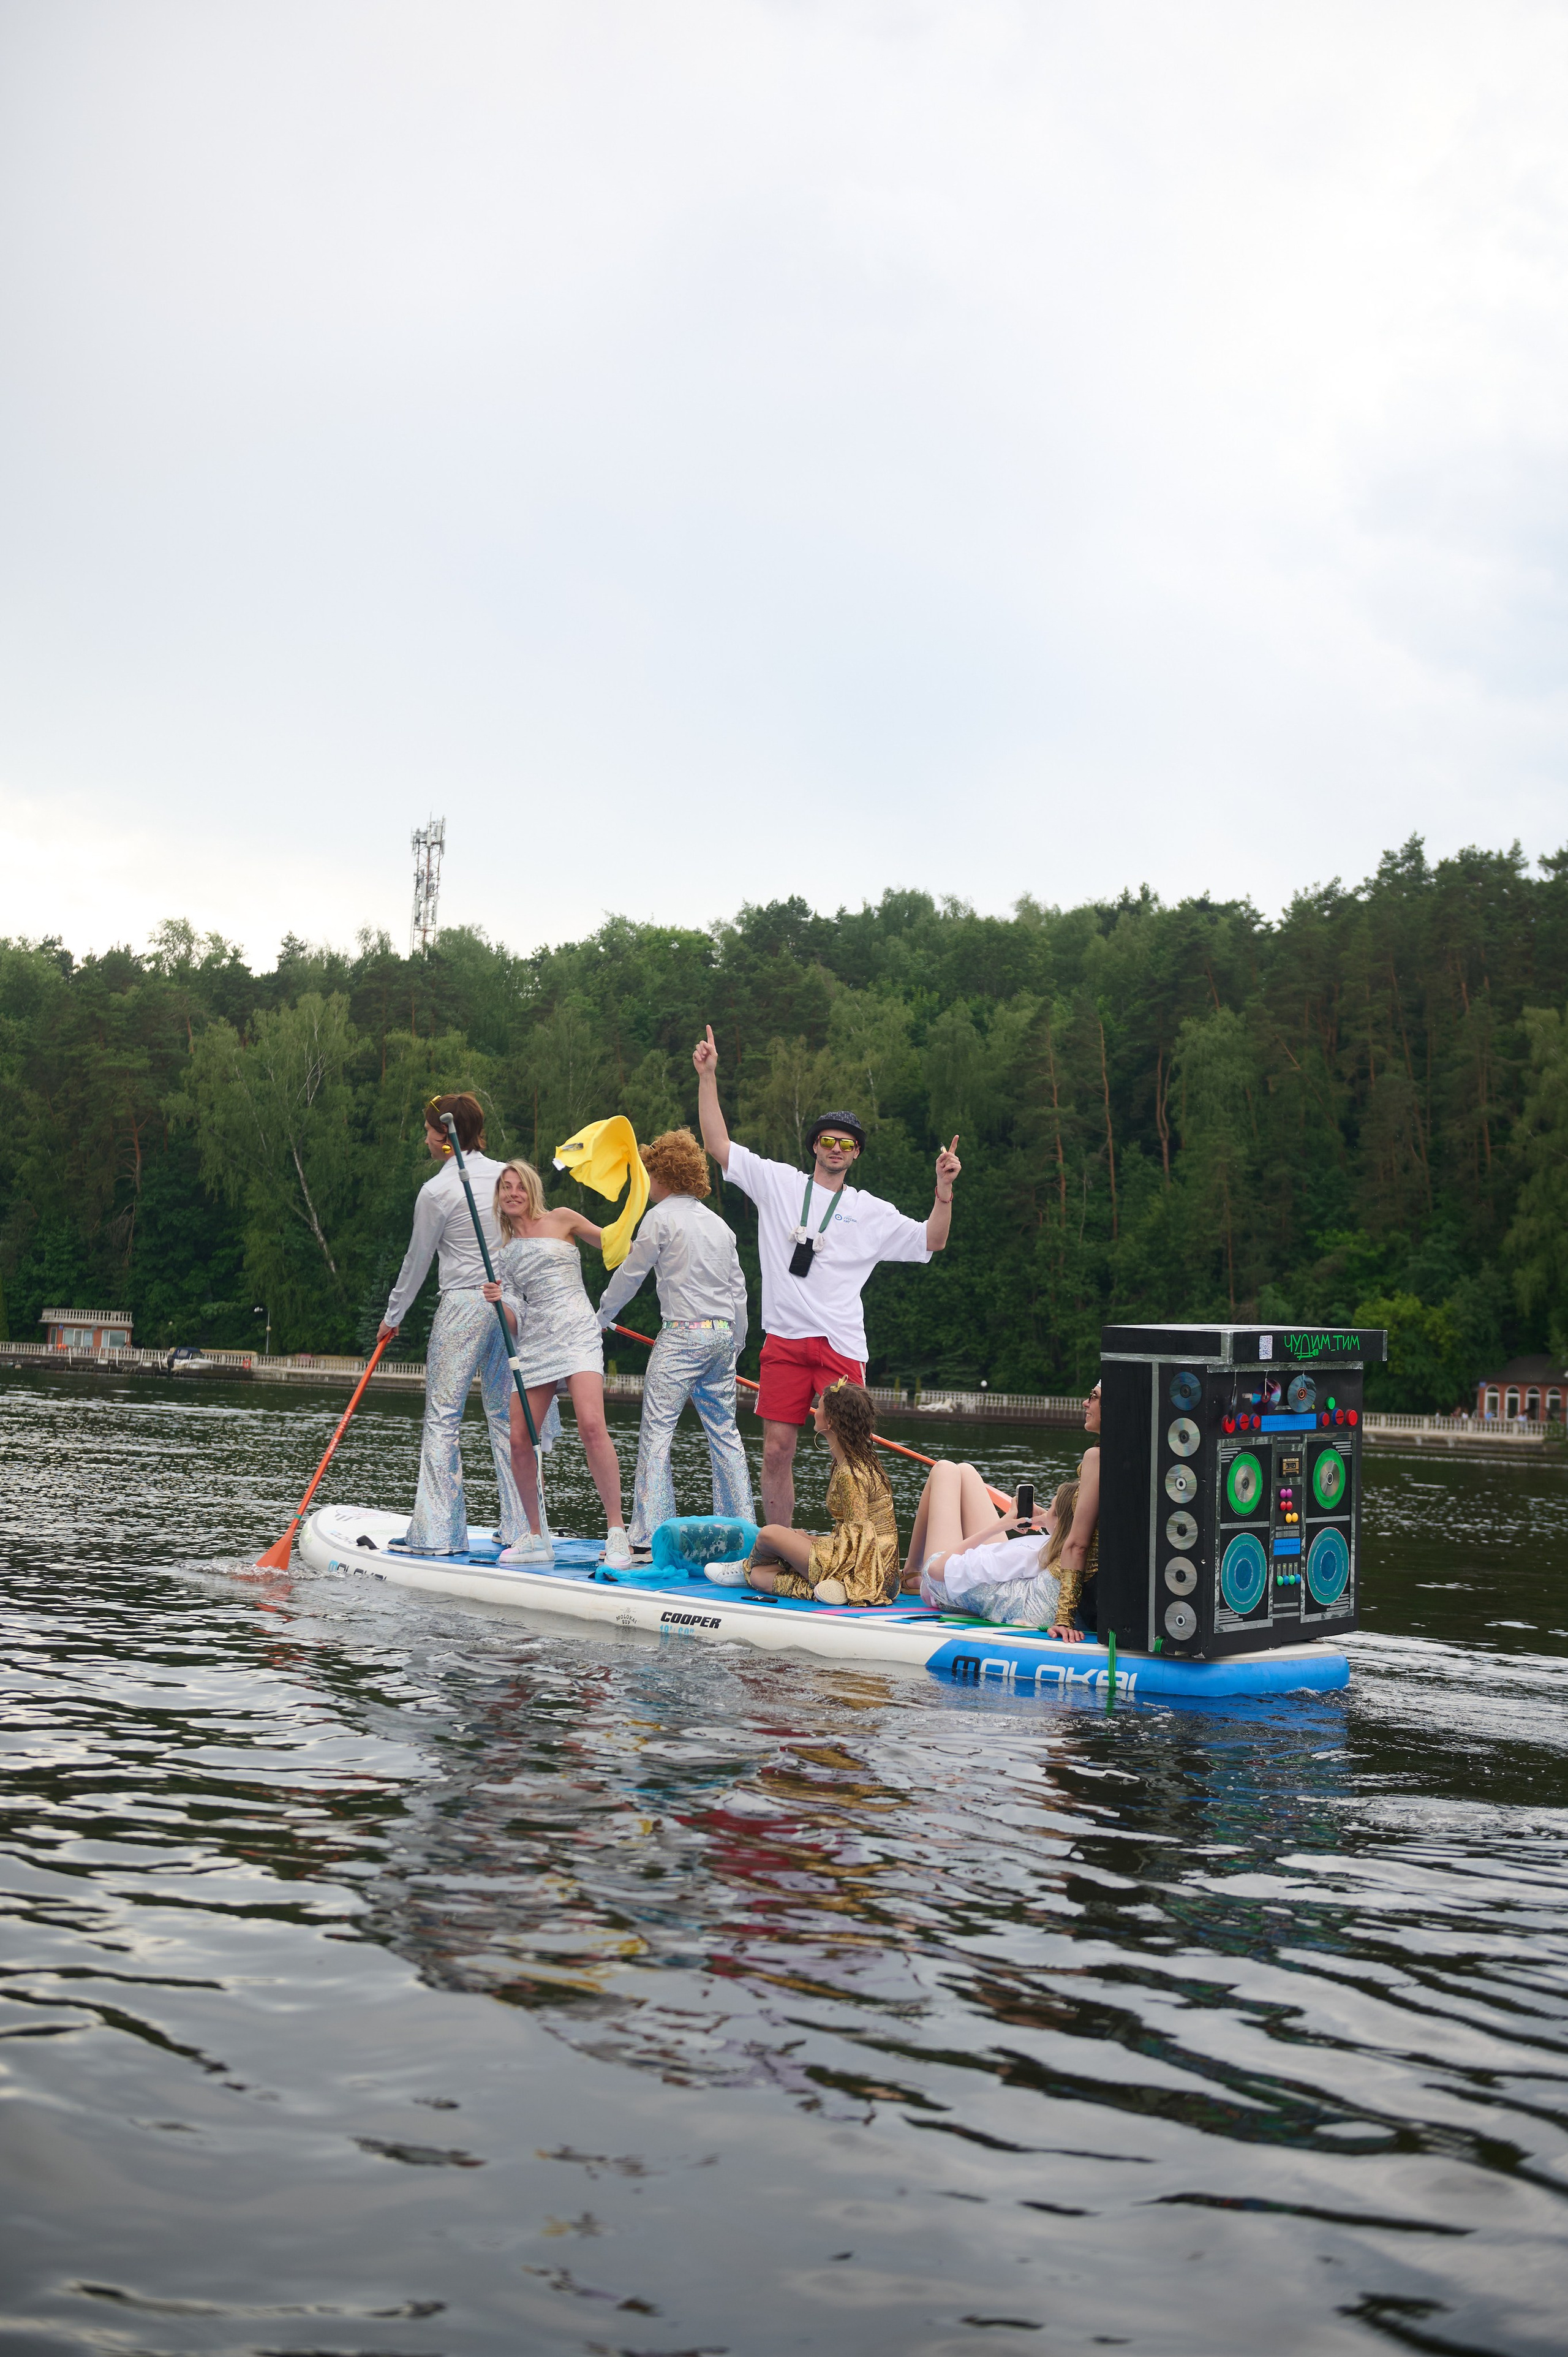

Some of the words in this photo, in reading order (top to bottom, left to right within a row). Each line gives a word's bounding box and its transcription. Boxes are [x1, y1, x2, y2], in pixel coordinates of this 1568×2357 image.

[616, 1614, 637, 1624] MOLOKAI
[660, 1611, 722, 1629] COOPER
[952, 1655, 1138, 1691] MOLOKAI
